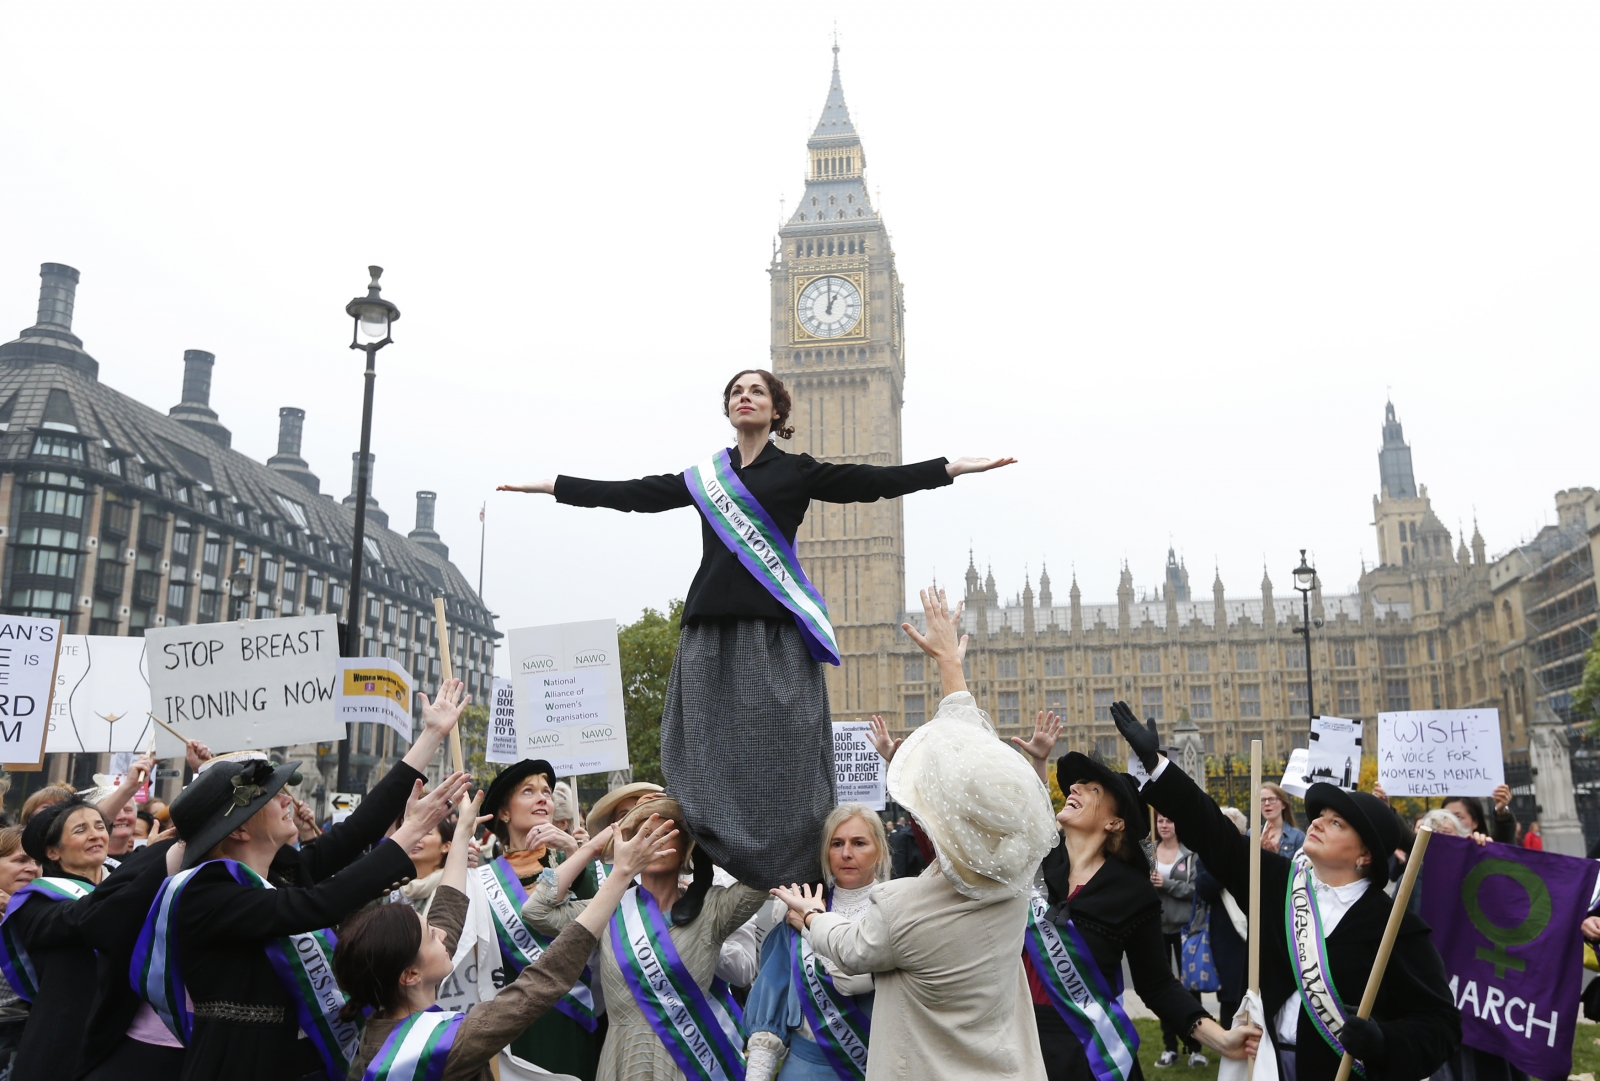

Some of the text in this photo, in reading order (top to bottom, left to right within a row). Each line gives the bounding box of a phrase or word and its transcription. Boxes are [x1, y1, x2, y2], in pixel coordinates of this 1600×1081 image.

[730, 511, 745, 529] FOR
[743, 524, 790, 583] WOMEN
[163, 629, 325, 670] STOP BREAST
[24, 654, 39, 666] IS
[353, 673, 376, 682] Women
[544, 676, 576, 687] National
[164, 674, 336, 724] IRONING NOW
[544, 690, 574, 699] Alliance
[545, 700, 582, 710] Women's
[496, 708, 514, 717] OUR
[546, 712, 598, 724] Organisations
[495, 718, 514, 727] OUR
[494, 726, 506, 736] TO
[834, 732, 852, 742] OUR
[1394, 720, 1468, 743] WISH
[835, 742, 866, 751] BODIES
[834, 752, 879, 762] OUR LIVES
[1385, 747, 1477, 763] A VOICE FOR
[856, 763, 880, 772] RIGHT
[848, 772, 878, 782] DECIDE
[1381, 768, 1492, 780] WOMEN'S MENTAL
[1408, 783, 1449, 794] HEALTH
[496, 898, 511, 917] FOR
[505, 914, 544, 960] WOME
[1298, 942, 1307, 962] FOR
[1040, 920, 1093, 1010] FOR WOMEN
[297, 935, 339, 1015] OTES FOR
[804, 952, 832, 1011] VOTES
[828, 1012, 842, 1031] FOR
[634, 934, 718, 1072] VOTES FOR WOMEN
